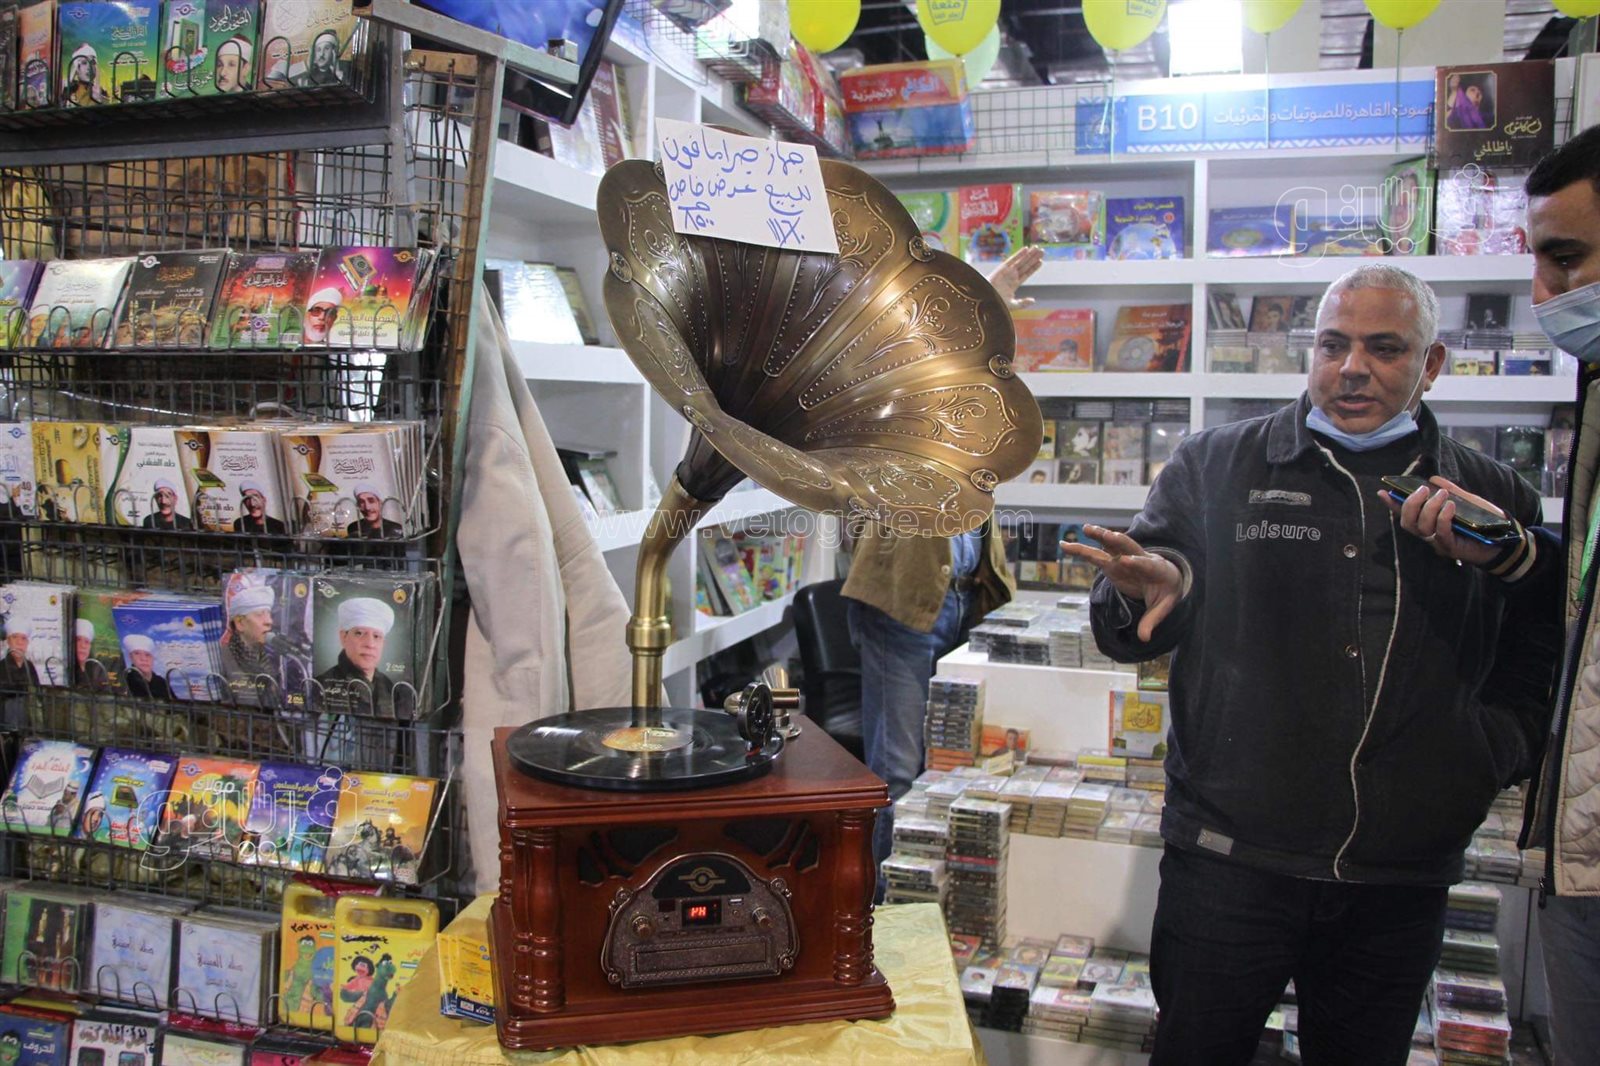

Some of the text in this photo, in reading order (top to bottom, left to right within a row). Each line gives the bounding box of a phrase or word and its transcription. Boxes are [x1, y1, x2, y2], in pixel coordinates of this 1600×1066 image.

[1138, 103, 1198, 131] B10
[1213, 101, 1433, 126] صوت القاهرة للصوتيات ولمرئيات
[669, 174, 812, 216] للبيع عرض خاص
[1235, 520, 1322, 542] Leisure
